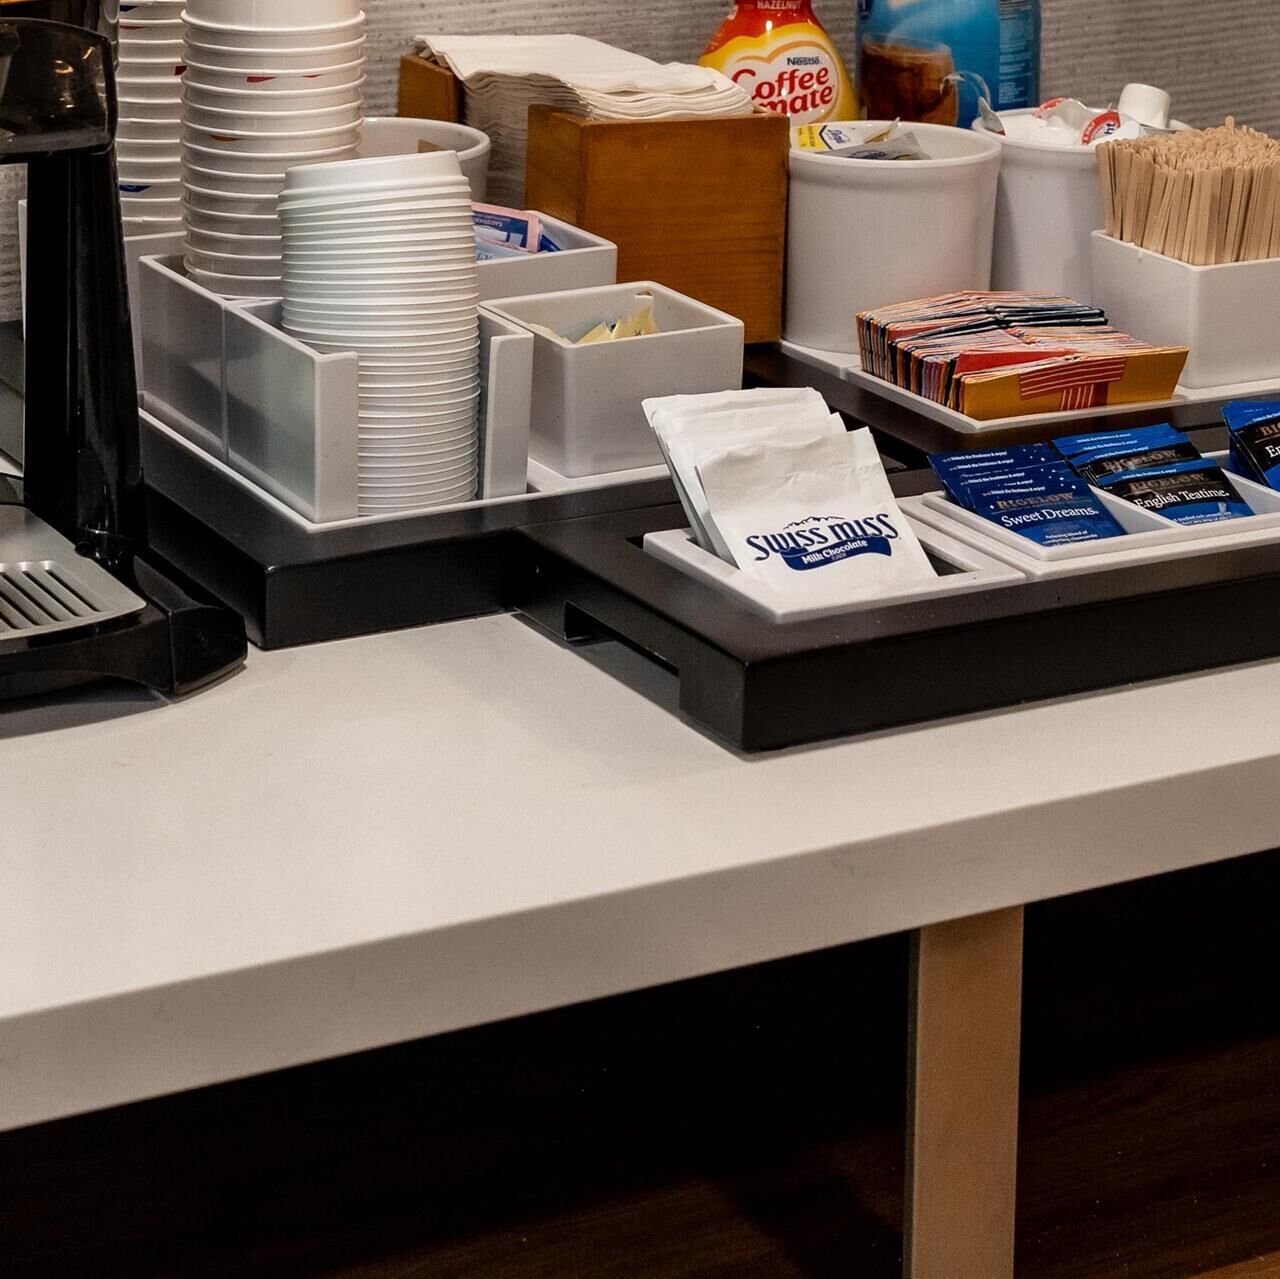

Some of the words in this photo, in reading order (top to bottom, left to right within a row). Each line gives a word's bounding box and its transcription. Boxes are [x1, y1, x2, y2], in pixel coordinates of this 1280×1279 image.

[757, 0, 802, 9] HAZELNUT
[997, 493, 1074, 509] BIGELOW
[1134, 491, 1182, 509] English
[1001, 513, 1040, 528] Sweet
[801, 550, 824, 565] Milk
[823, 539, 868, 558] Chocolate
